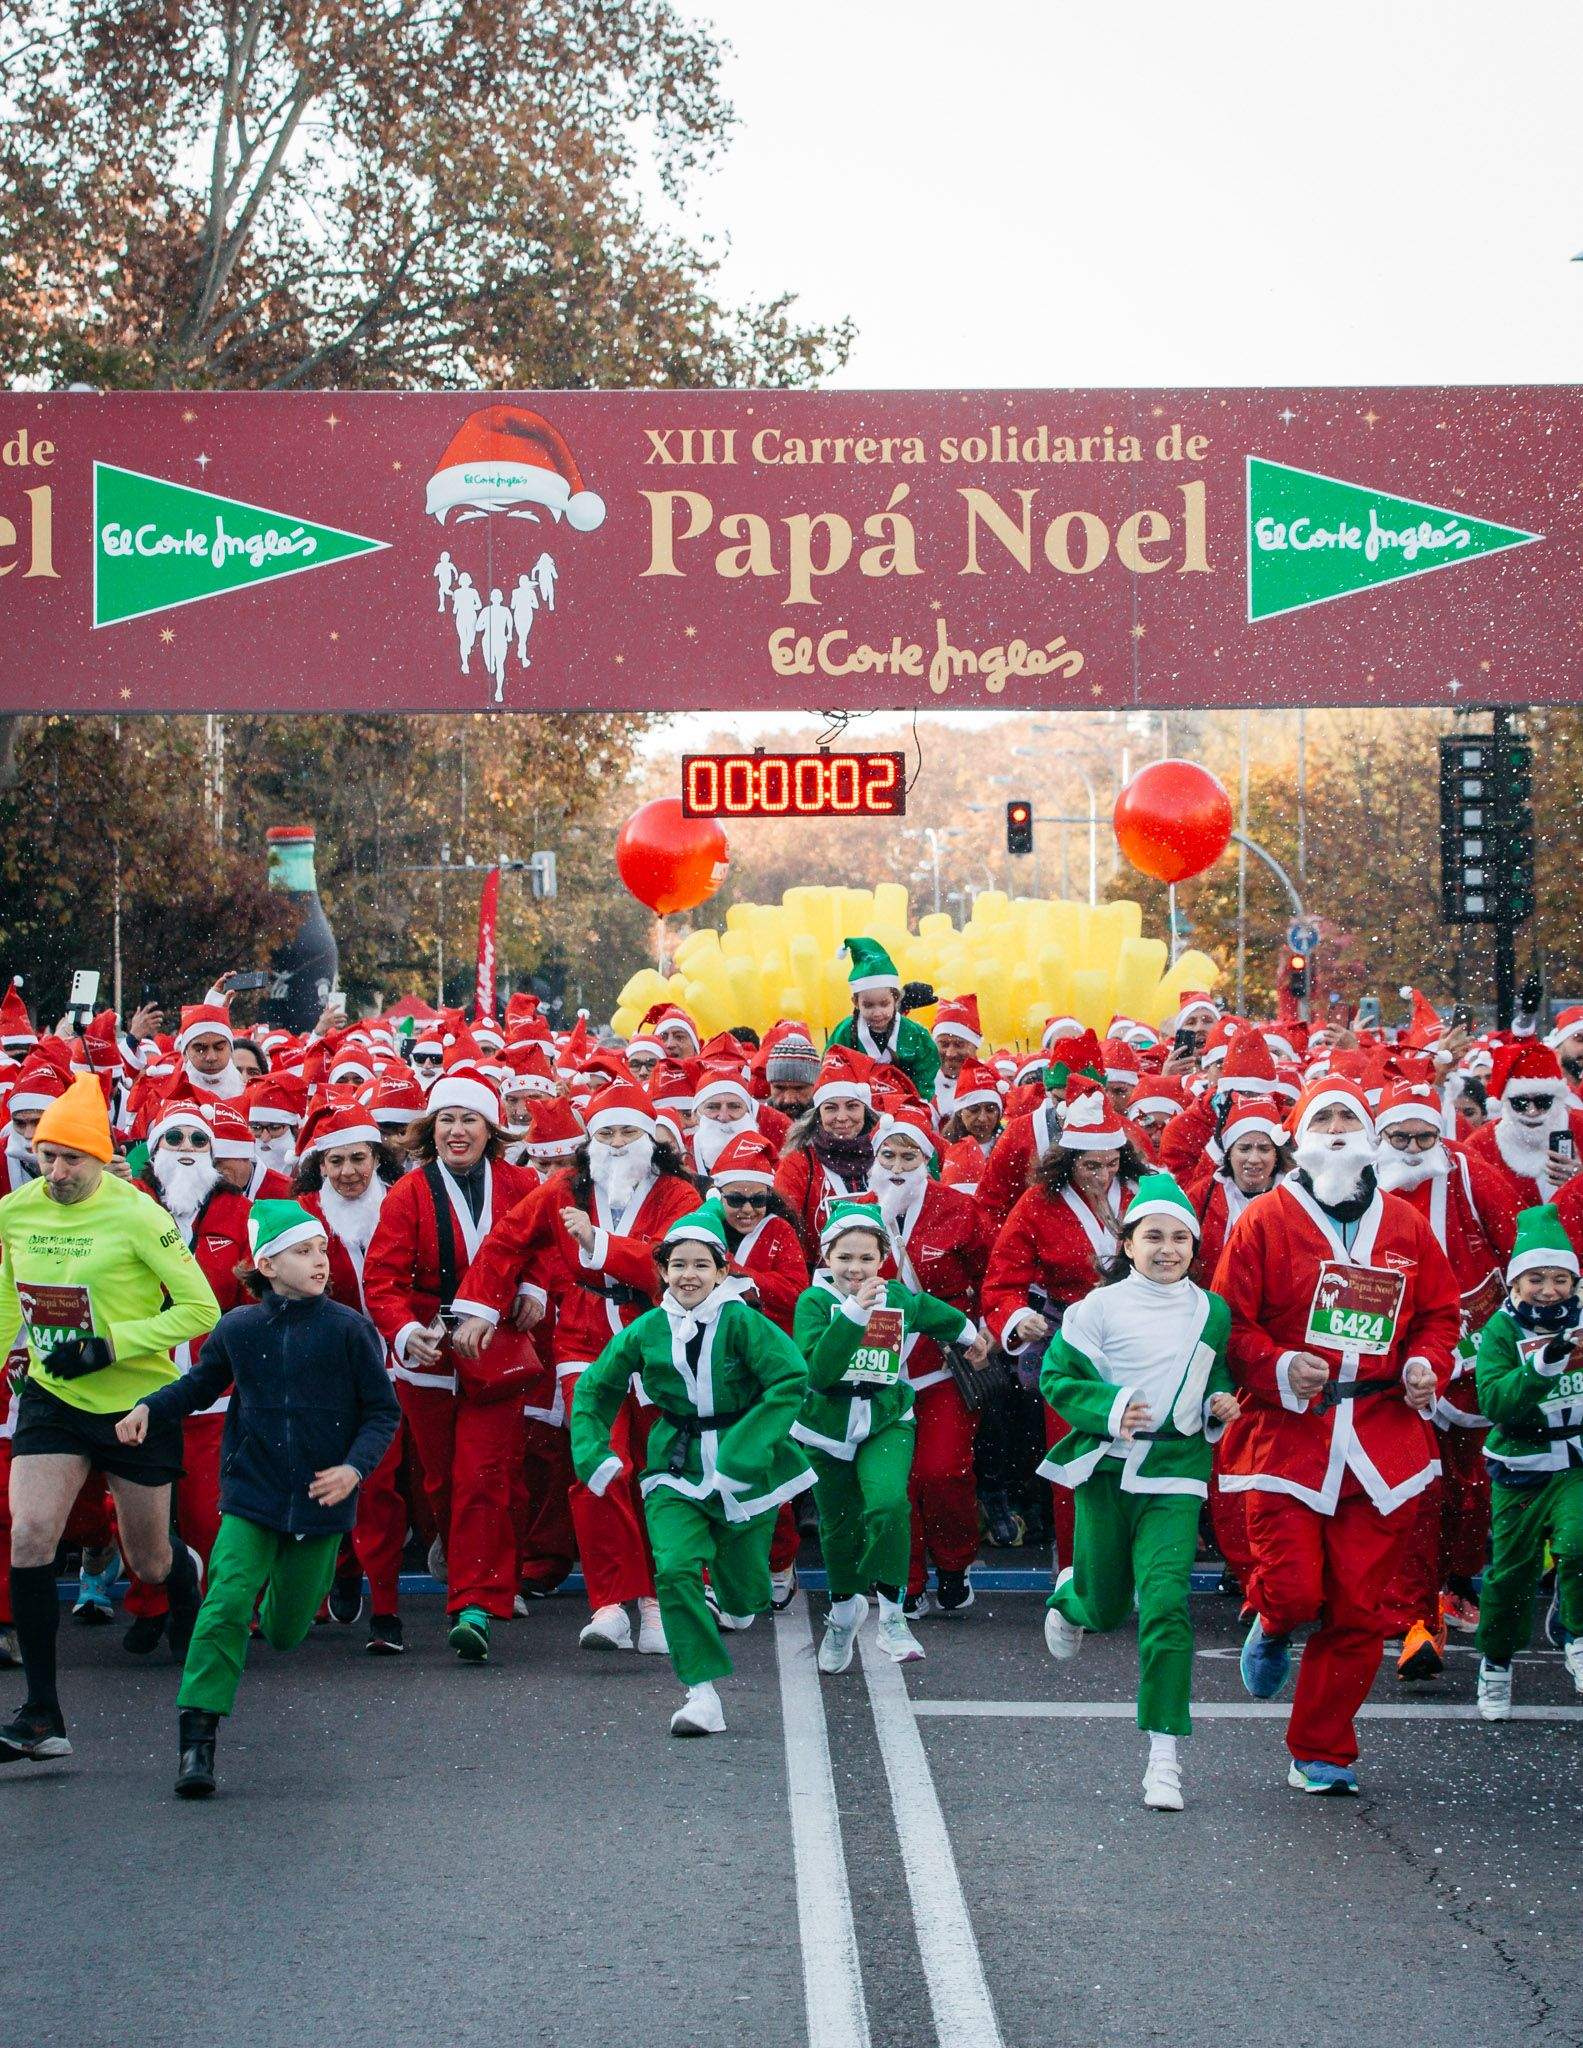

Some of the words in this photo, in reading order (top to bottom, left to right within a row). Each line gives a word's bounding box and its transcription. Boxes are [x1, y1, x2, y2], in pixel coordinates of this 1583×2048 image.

[2, 429, 55, 467] de
[643, 429, 738, 464] XIII
[752, 428, 928, 464] Carrera
[939, 425, 1143, 463] solidaria
[1155, 424, 1210, 461] de
[101, 522, 134, 557] El
[135, 524, 209, 557] Corte
[211, 516, 317, 568] Inglés
[637, 482, 926, 605] Papá
[956, 480, 1216, 574] Noel
[1255, 517, 1288, 550] El
[1289, 517, 1362, 550] Corte
[1364, 509, 1471, 562] Inglés
[768, 627, 815, 676] El
[817, 629, 924, 676] Corte
[929, 618, 1084, 694] Inglés
[689, 759, 895, 811] 00:00:02
[1330, 1310, 1384, 1340] 6424
